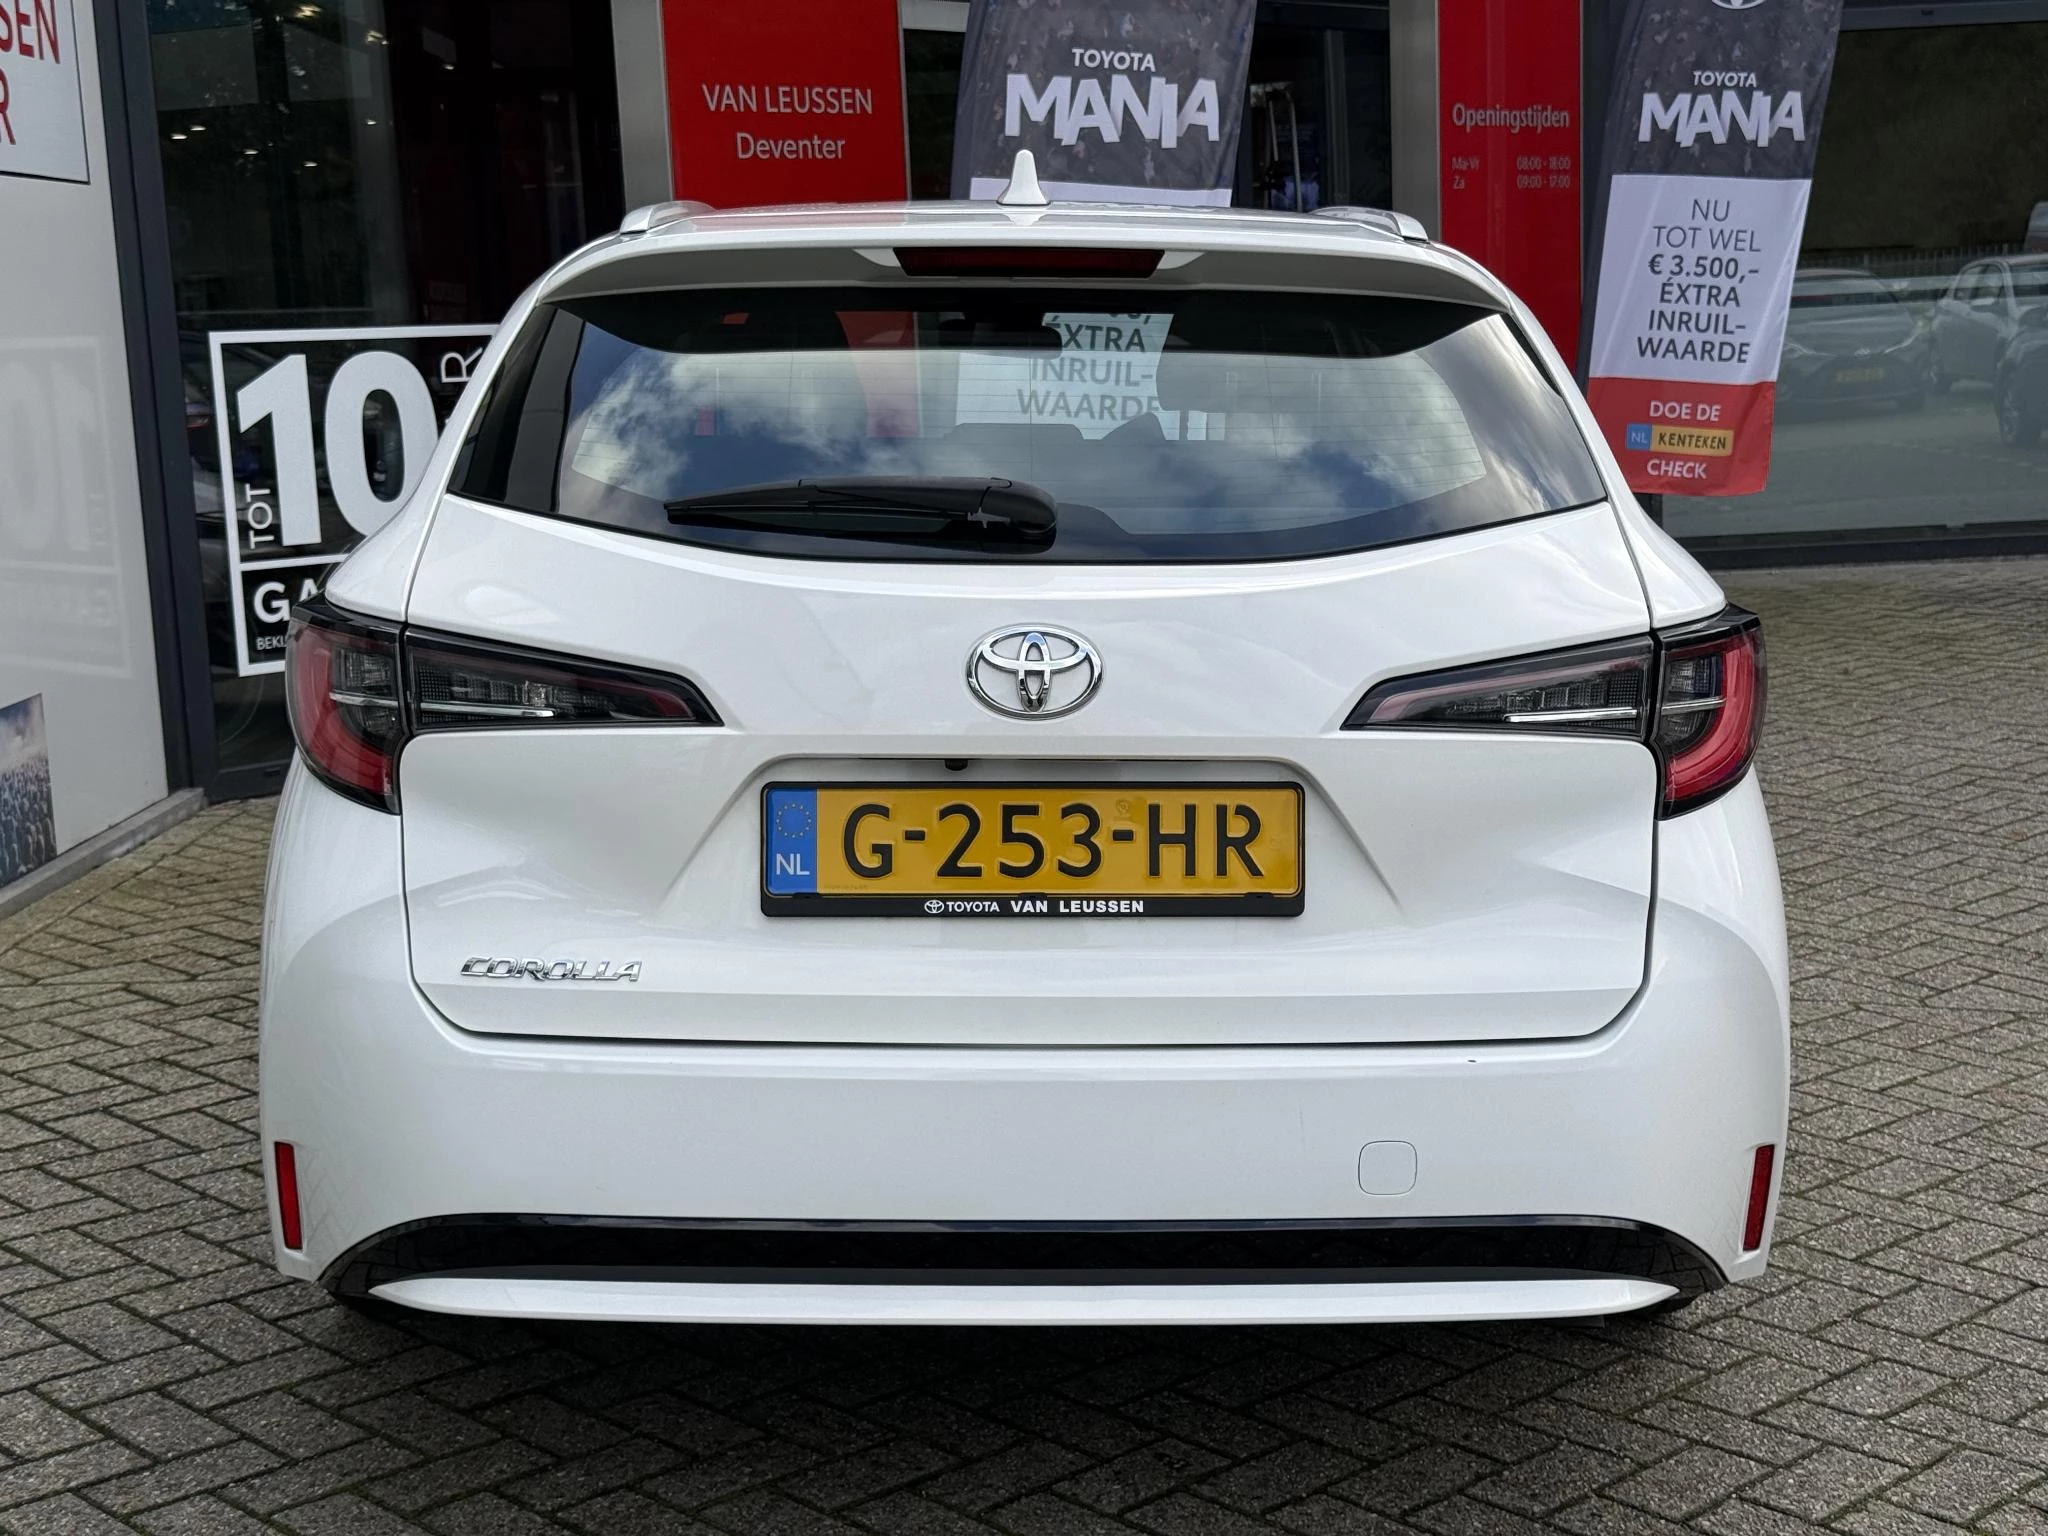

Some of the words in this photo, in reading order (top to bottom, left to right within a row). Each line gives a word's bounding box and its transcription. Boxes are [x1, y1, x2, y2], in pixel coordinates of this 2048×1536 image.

[1072, 48, 1156, 72] TOYOTA
[1693, 71, 1758, 88] TOYOTA
[702, 84, 757, 113] VAN
[764, 86, 873, 114] LEUSSEN
[1005, 74, 1220, 149] MANIA
[1452, 102, 1570, 133] Openingstijden
[1638, 90, 1806, 148] MANIA
[736, 132, 846, 160] Deventer
[1691, 199, 1731, 222] NU
[1653, 225, 1702, 249] TOT
[1709, 228, 1761, 252] WEL
[1659, 277, 1740, 307] ÉXTRA
[1648, 310, 1746, 335] INRUIL-
[1637, 336, 1750, 363] WAARDE
[1031, 356, 1153, 387] INRUIL-
[1649, 400, 1692, 419] DOE
[1696, 403, 1721, 421] DE
[237, 350, 440, 546] 10
[1631, 432, 1648, 443] NL
[1658, 432, 1726, 450] KENTEKEN
[1646, 459, 1707, 479] CHECK
[246, 483, 275, 549] TOT
[844, 803, 1264, 879] G-253-HR
[775, 853, 810, 876] NL
[947, 901, 1000, 913] TOYOTA
[1010, 900, 1048, 913] VAN
[1059, 900, 1144, 913] LEUSSEN
[460, 955, 642, 982] COROLLA
